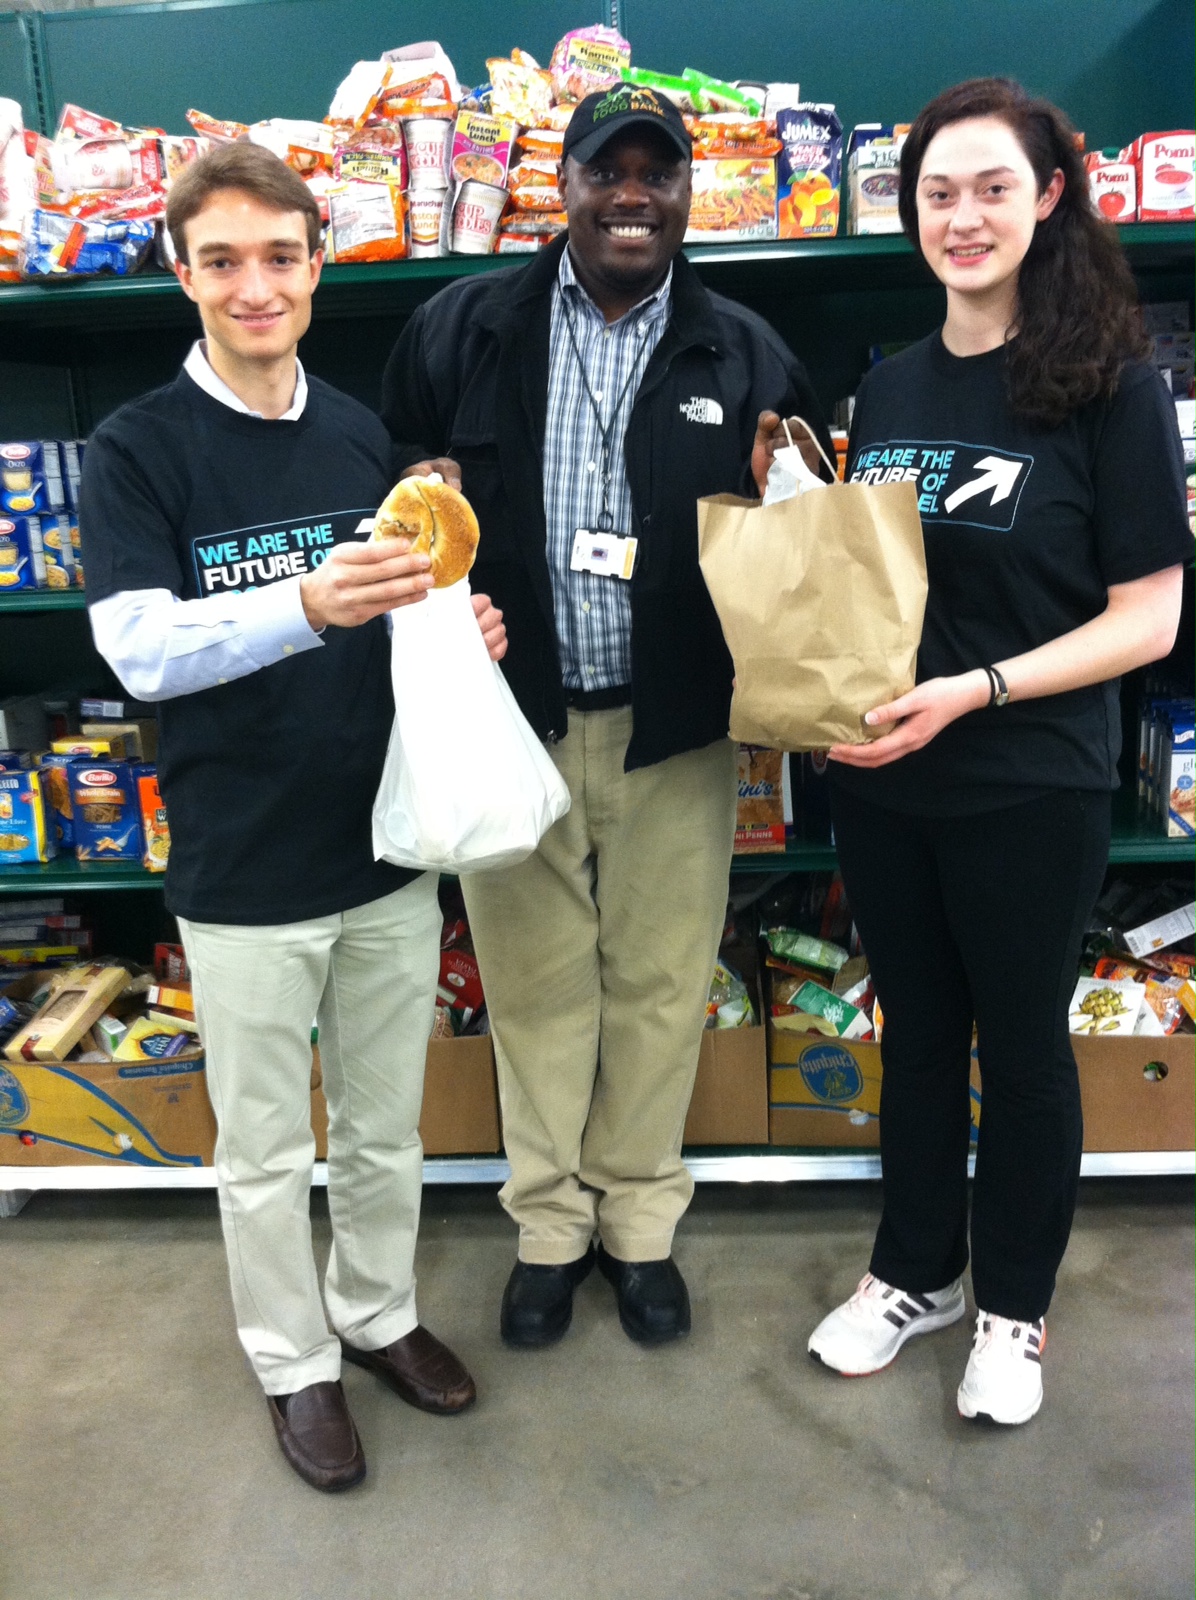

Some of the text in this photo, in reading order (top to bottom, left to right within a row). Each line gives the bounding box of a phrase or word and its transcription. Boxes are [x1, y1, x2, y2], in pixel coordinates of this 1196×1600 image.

[593, 97, 666, 123] FOOD BANK
[466, 122, 501, 136] Instant
[781, 121, 832, 141] JUMEX
[469, 131, 496, 143] Lunch
[1153, 144, 1195, 158] Pomi
[410, 154, 443, 169] OODL
[1097, 173, 1129, 183] Pomi
[412, 220, 439, 229] Lunch
[690, 396, 707, 406] THE
[679, 402, 707, 415] NORTH
[686, 413, 707, 424] FACE
[920, 450, 955, 470] THE
[850, 466, 948, 492] FUTURE OF
[199, 523, 335, 566] WE ARE THE
[203, 551, 308, 591] FUTURE
[87, 773, 114, 782] Barilla
[79, 789, 121, 797] Whole Grain
[745, 831, 773, 839] PENNE
[801, 1053, 855, 1075] Chiquita
